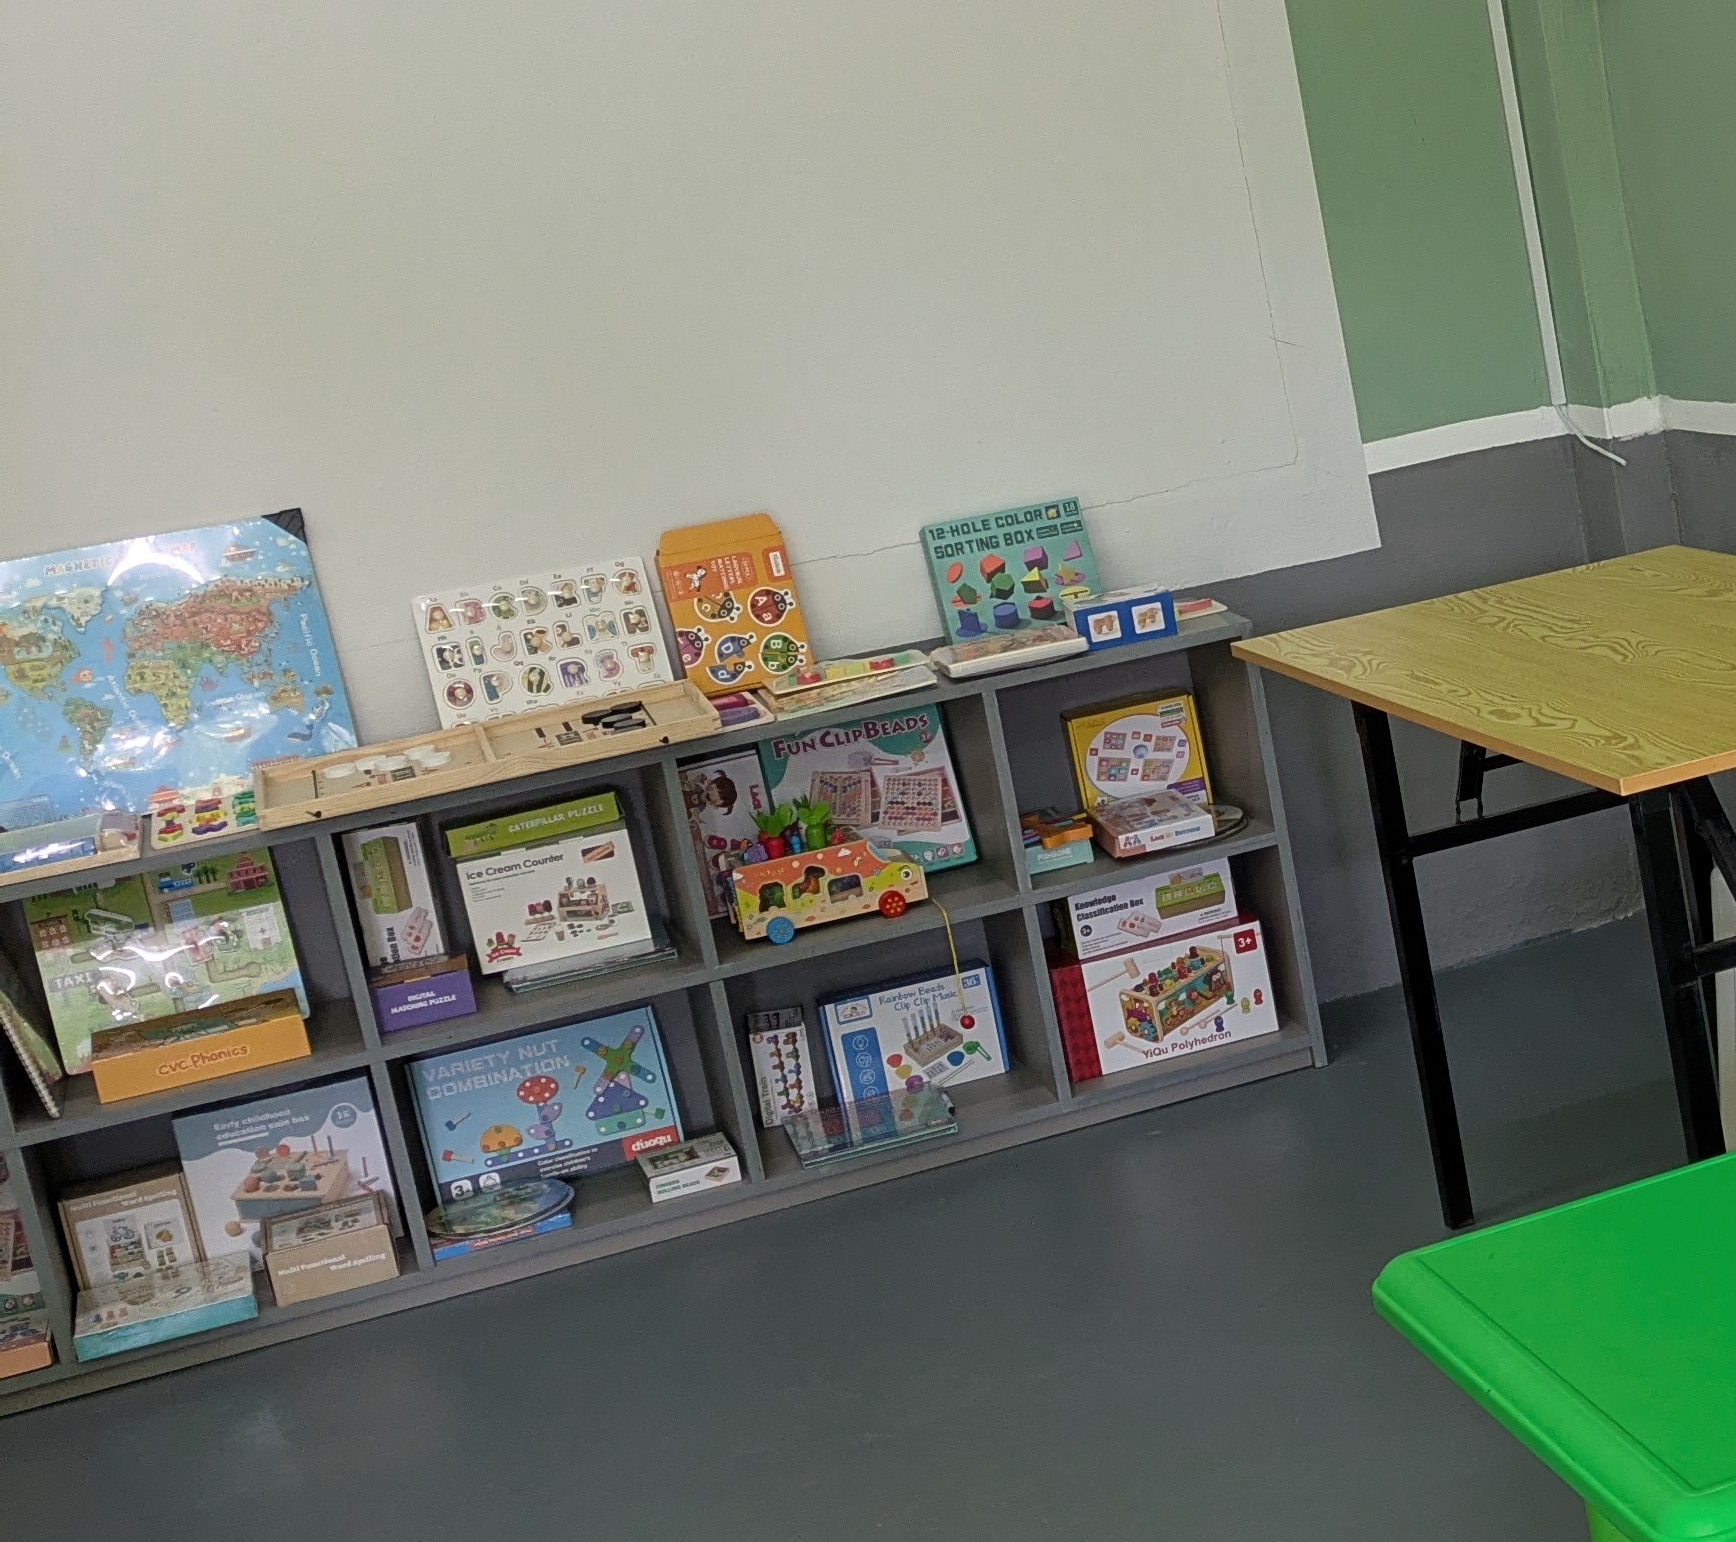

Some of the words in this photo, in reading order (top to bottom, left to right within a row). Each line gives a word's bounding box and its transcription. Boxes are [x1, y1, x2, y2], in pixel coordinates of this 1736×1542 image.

[1064, 501, 1076, 512] 18
[928, 518, 992, 541] 12-HOLE
[994, 509, 1043, 529] COLOR
[933, 535, 1000, 560] SORTING
[1003, 528, 1036, 547] BOX
[754, 595, 767, 607] A
[762, 612, 773, 622] a
[721, 643, 734, 654] D
[770, 639, 783, 649] B
[682, 653, 692, 663] e
[767, 661, 780, 670] b
[717, 670, 730, 679] d
[771, 739, 818, 760] FUN
[818, 728, 863, 749] CLIP
[861, 713, 929, 741] BEADS
[508, 811, 566, 833] CATERPILLAR
[567, 803, 605, 817] PUZZLE
[466, 869, 483, 881] Ice
[485, 862, 522, 877] Cream
[523, 853, 565, 869] Counter
[1075, 893, 1117, 911] Knowledge
[1076, 901, 1129, 922] Classification
[1130, 897, 1144, 908] Box
[1237, 936, 1252, 948] 3+
[54, 972, 93, 990] TAXI
[408, 991, 436, 1002] DIGITAL
[879, 990, 916, 1005] Rainbow
[917, 983, 945, 996] Beads
[894, 999, 911, 1011] Clip
[913, 994, 930, 1008] Clip
[932, 989, 958, 1002] Music
[390, 1000, 428, 1014] MATCHING
[429, 994, 457, 1007] PUZZLE
[1142, 1045, 1169, 1059] YiQu
[1171, 1030, 1232, 1052] Polyhedron
[191, 1044, 249, 1068] Phonics
[421, 1049, 511, 1083] VARIETY
[518, 1039, 558, 1060] NUT
[426, 1055, 571, 1101] COMBINATION
[213, 1119, 240, 1134] Early
